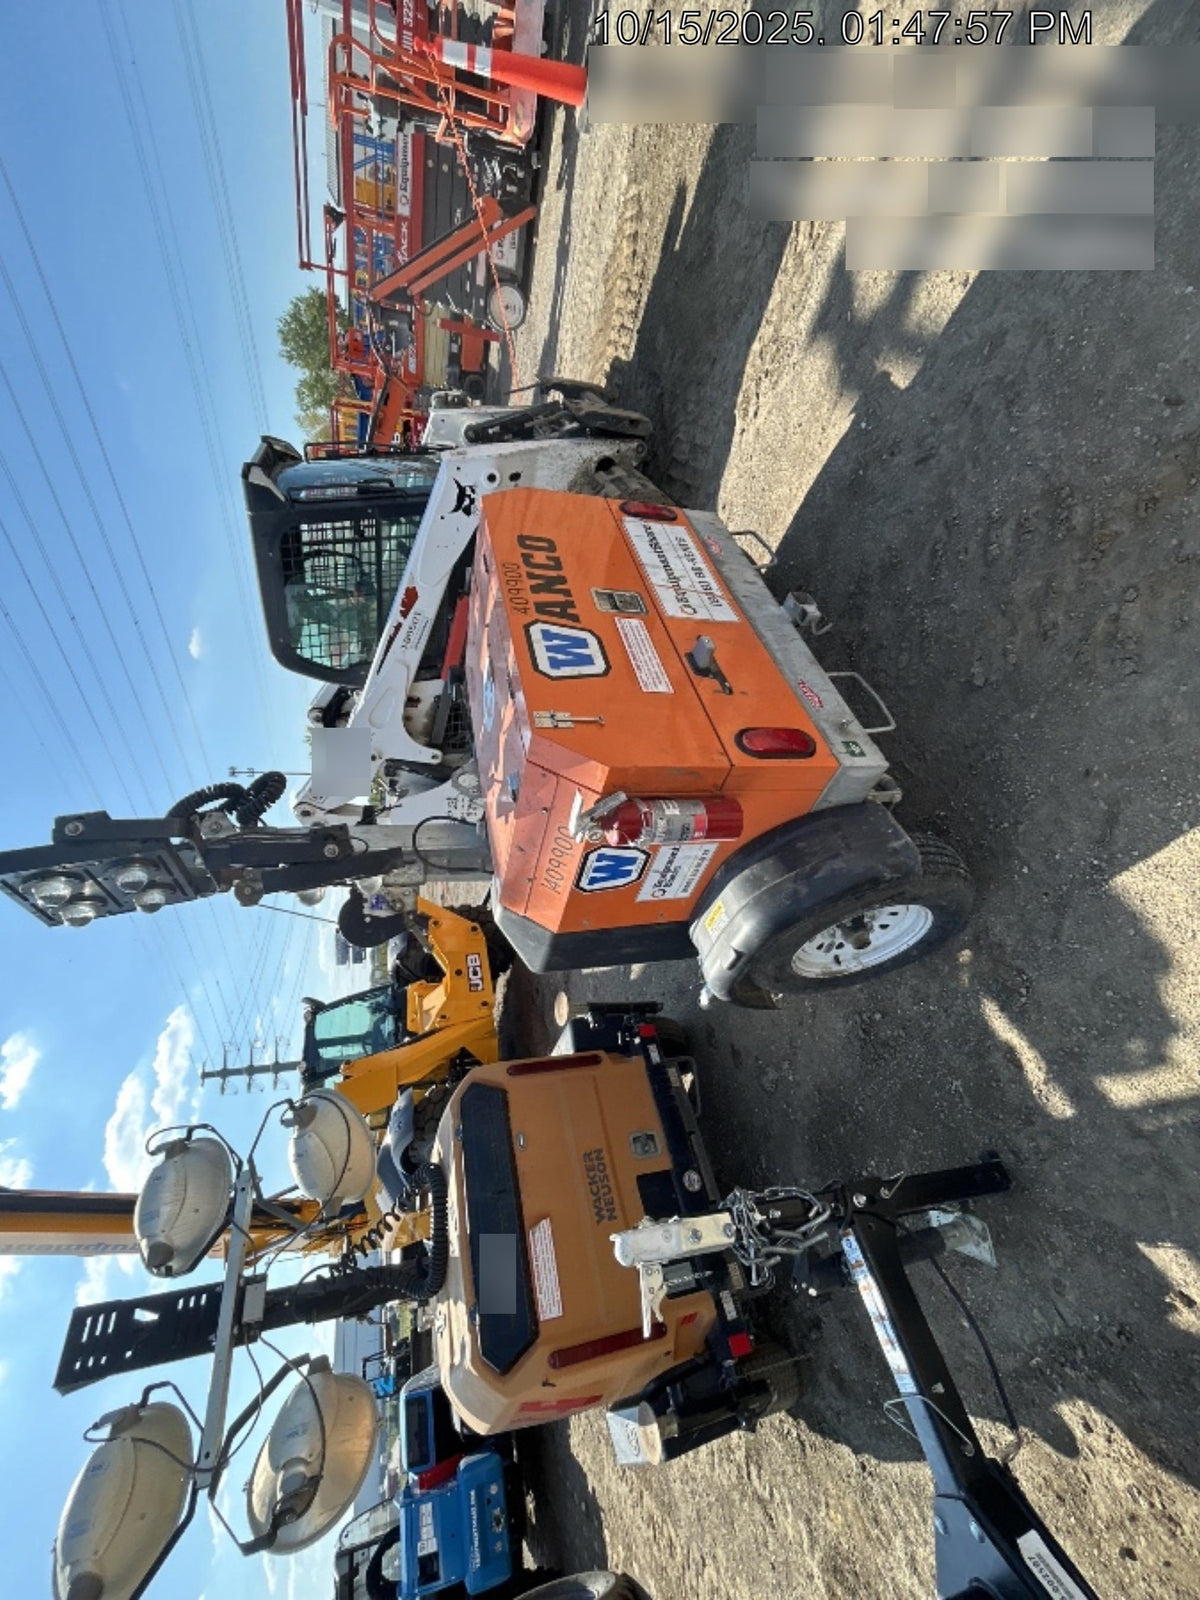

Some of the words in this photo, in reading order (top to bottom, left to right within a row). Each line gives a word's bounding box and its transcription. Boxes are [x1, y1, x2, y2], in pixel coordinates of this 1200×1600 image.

[502, 562, 531, 615] 409900
[517, 534, 596, 671] WANCO
[586, 852, 638, 886] W
[466, 954, 483, 991] JCB
[583, 1150, 605, 1224] WACKER
[593, 1148, 617, 1221] NEUSON
